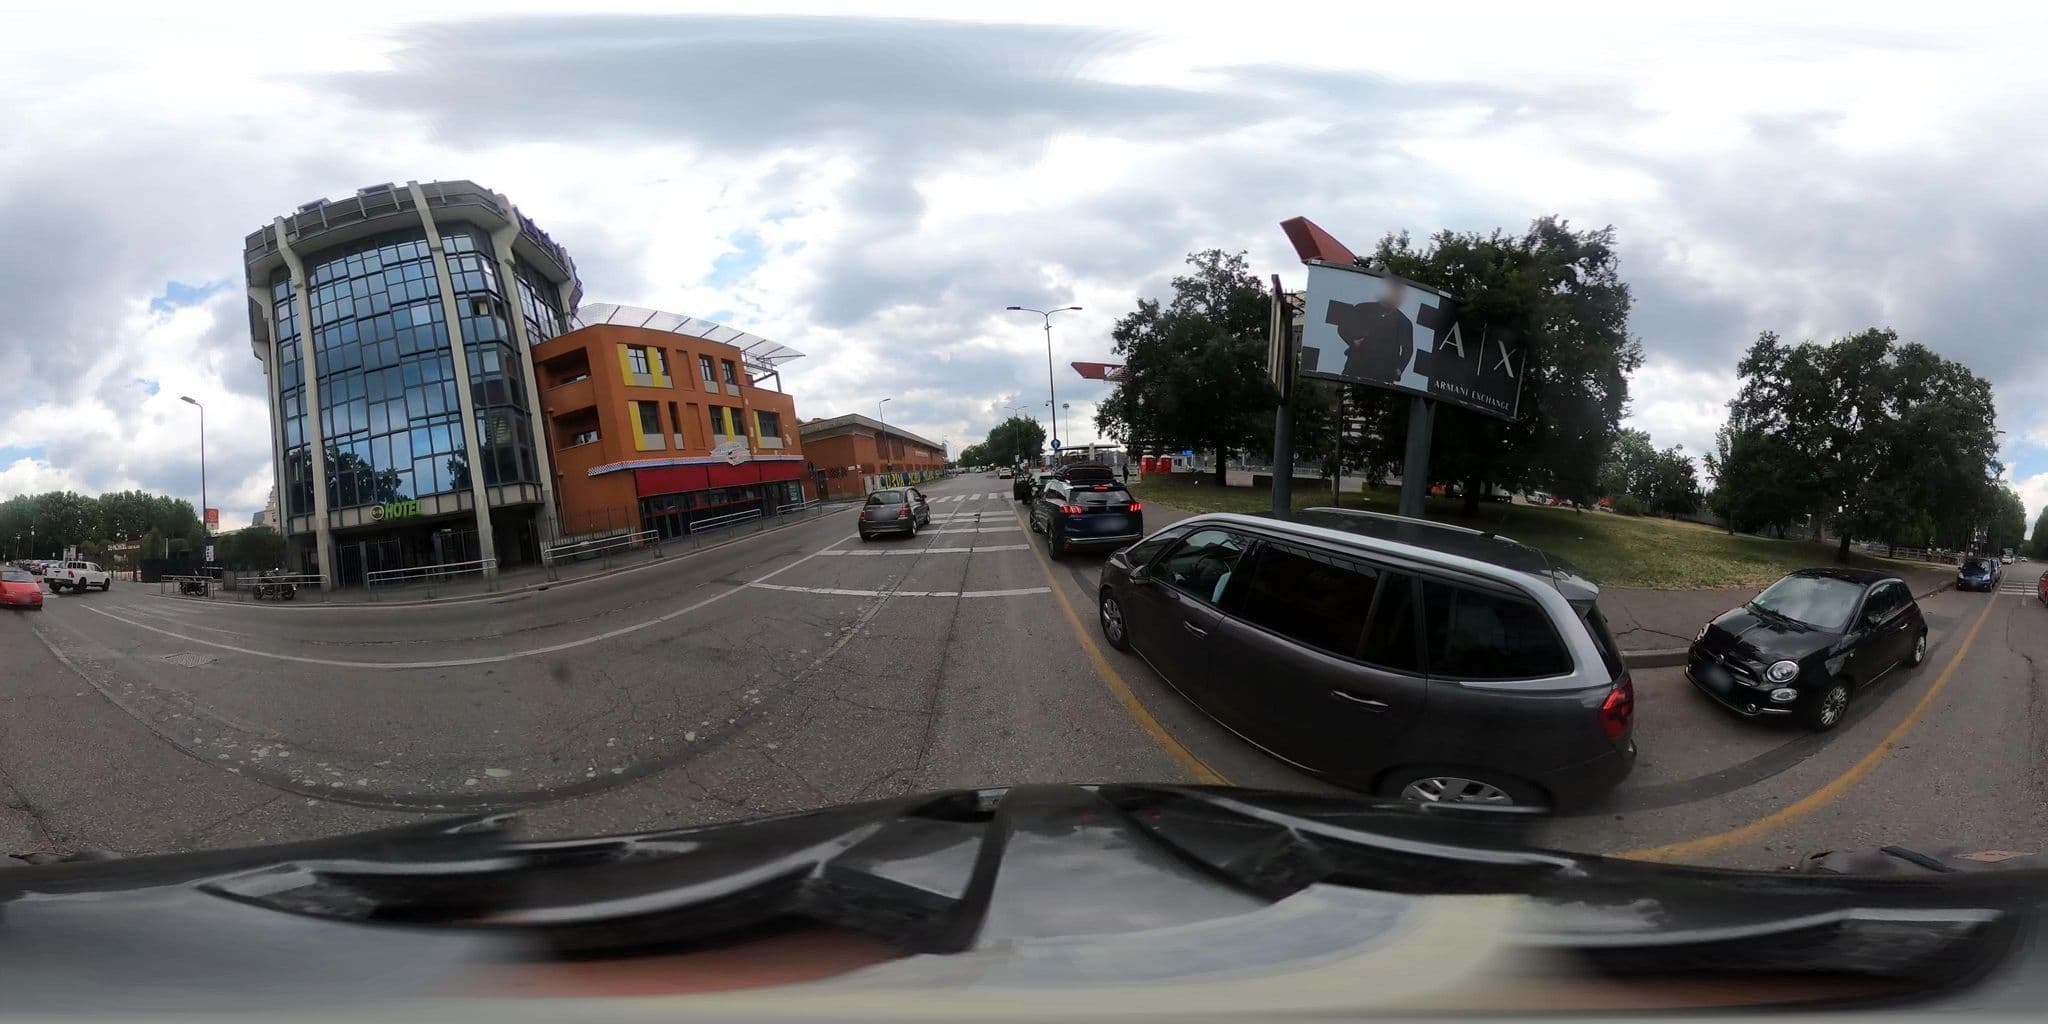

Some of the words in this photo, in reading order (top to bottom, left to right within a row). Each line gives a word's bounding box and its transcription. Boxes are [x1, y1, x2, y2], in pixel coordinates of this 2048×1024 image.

[1434, 380, 1469, 396] ARMANI
[1471, 391, 1509, 411] EXCHANGE
[385, 500, 421, 519] HOTEL
